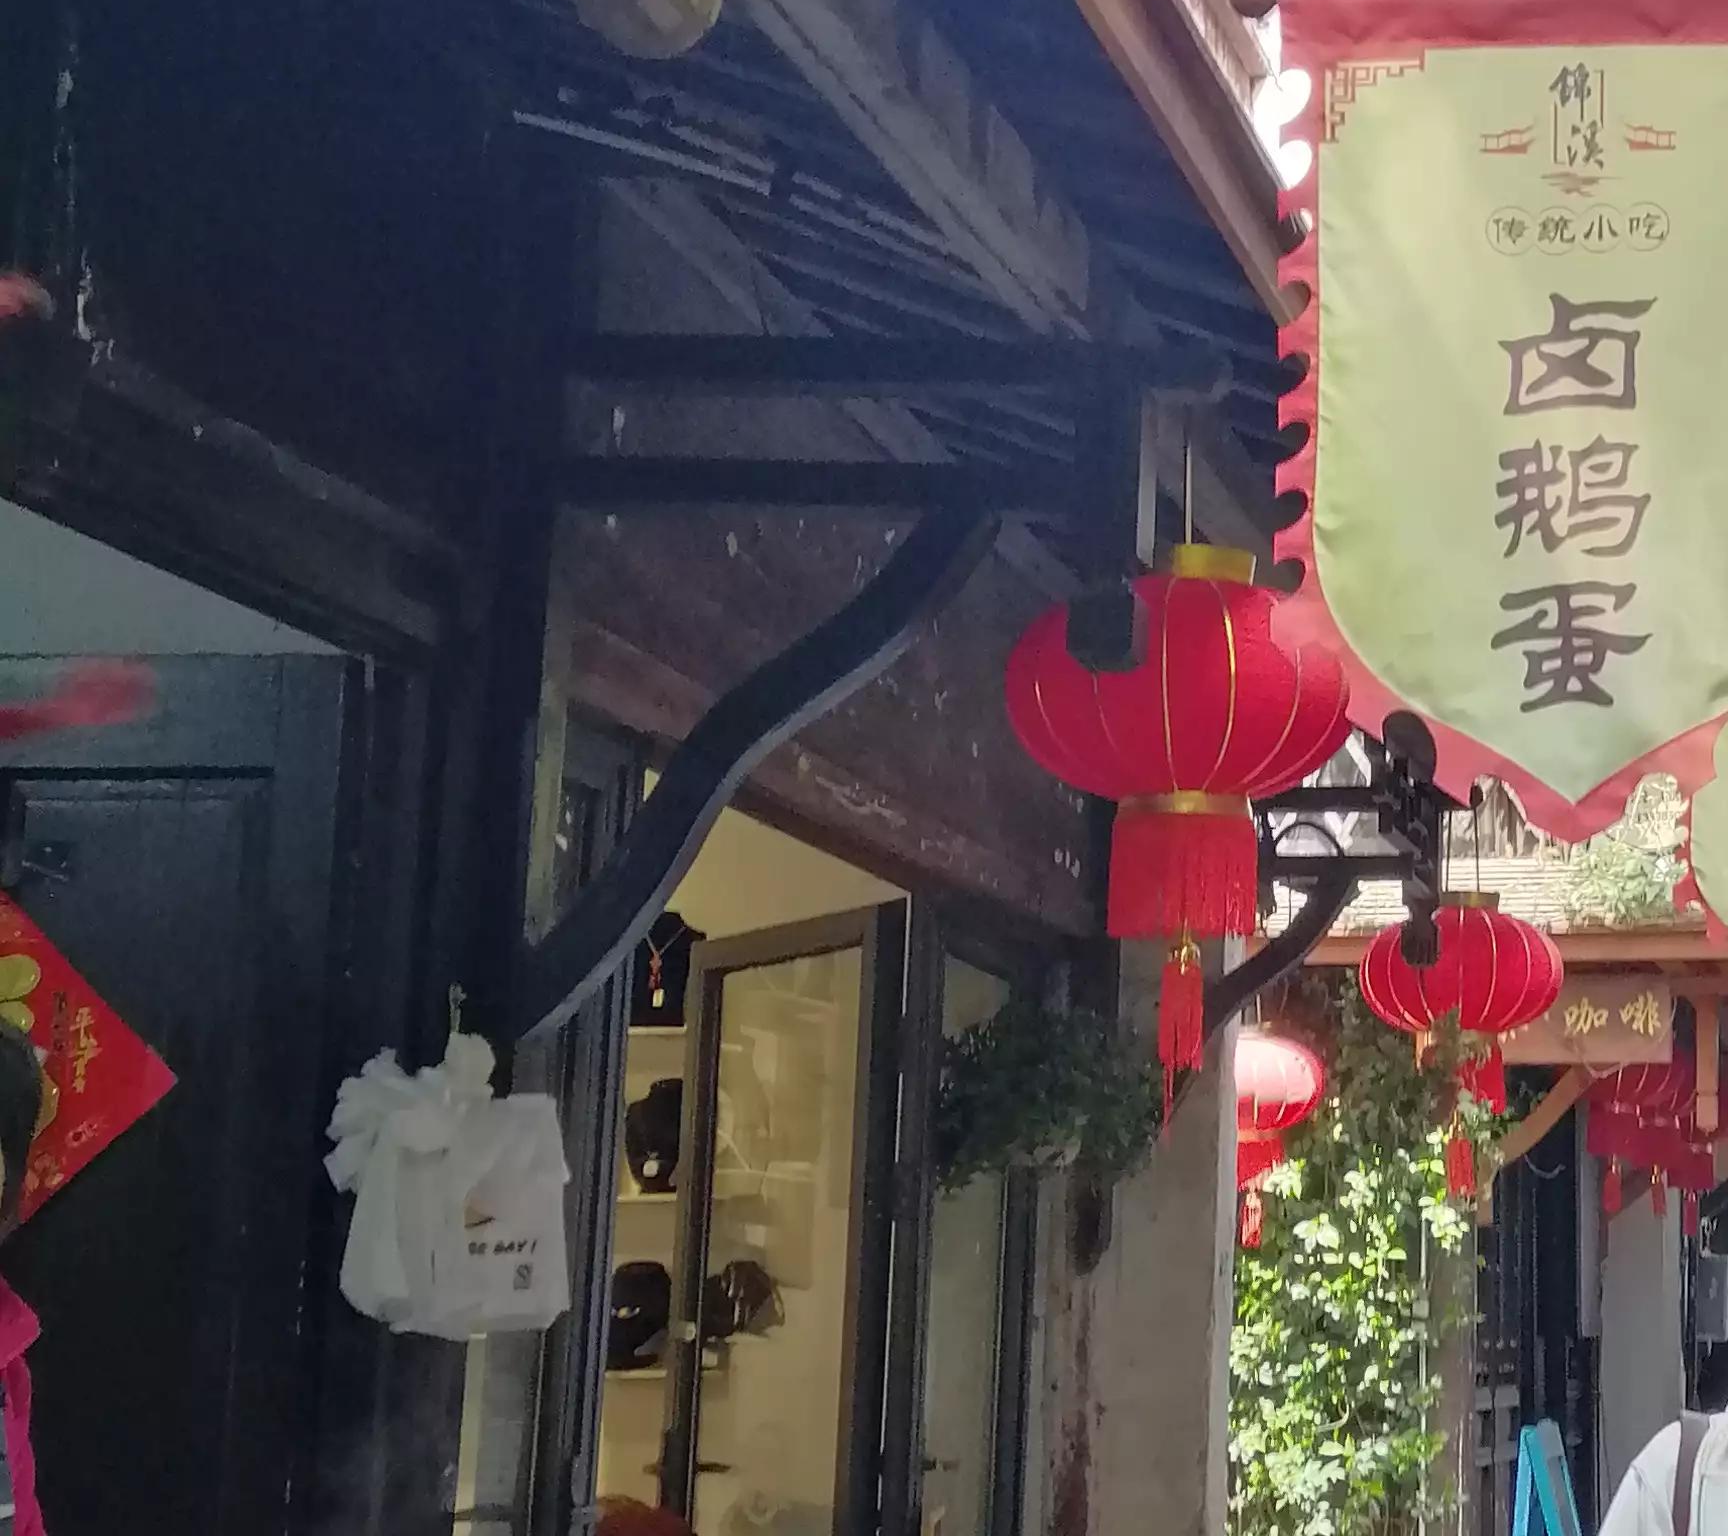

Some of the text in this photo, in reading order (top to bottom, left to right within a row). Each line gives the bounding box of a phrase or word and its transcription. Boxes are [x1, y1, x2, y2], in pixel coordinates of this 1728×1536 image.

[1490, 210, 1667, 248] 传统小吃
[1494, 292, 1658, 714] 卤鹅蛋
